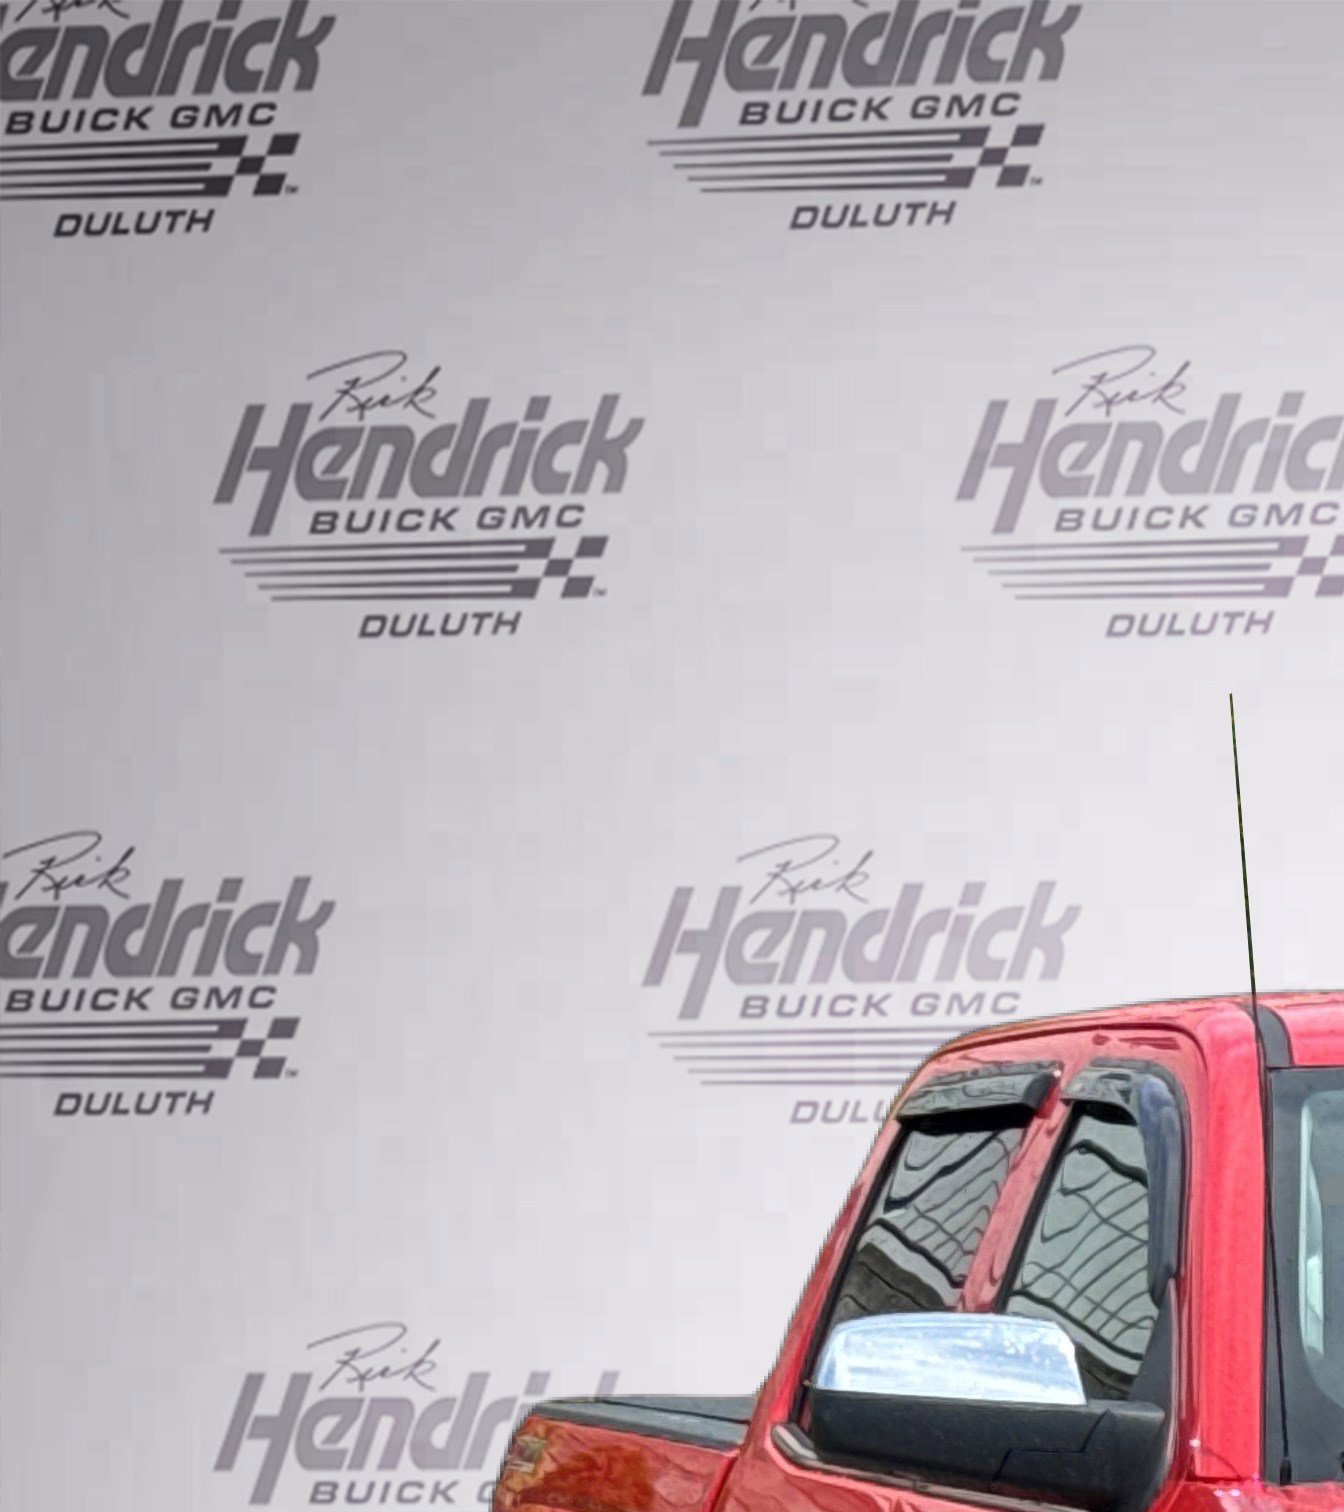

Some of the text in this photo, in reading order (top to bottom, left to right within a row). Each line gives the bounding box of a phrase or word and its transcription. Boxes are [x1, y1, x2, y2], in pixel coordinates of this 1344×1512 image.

[0, 0, 336, 101] endrick
[641, 0, 1081, 128] Hendrick
[4, 102, 277, 135] BUICK GMC
[739, 92, 1021, 126] BUICK GMC
[53, 209, 214, 237] DULUTH
[789, 201, 956, 230] DULUTH
[212, 393, 644, 536] Hendrick
[309, 504, 586, 535] BUICK GMC
[1052, 500, 1341, 533] BUICK GMC
[357, 611, 522, 639] DULUTH
[1104, 609, 1275, 638] DULUTH
[0, 875, 336, 980] endrick
[641, 881, 1081, 1020] Hendrick
[4, 986, 278, 1013] BUICK GMC
[739, 992, 1022, 1019] BUICK GMC
[53, 1090, 215, 1116] DULUTH
[309, 1481, 461, 1505] BUICK
